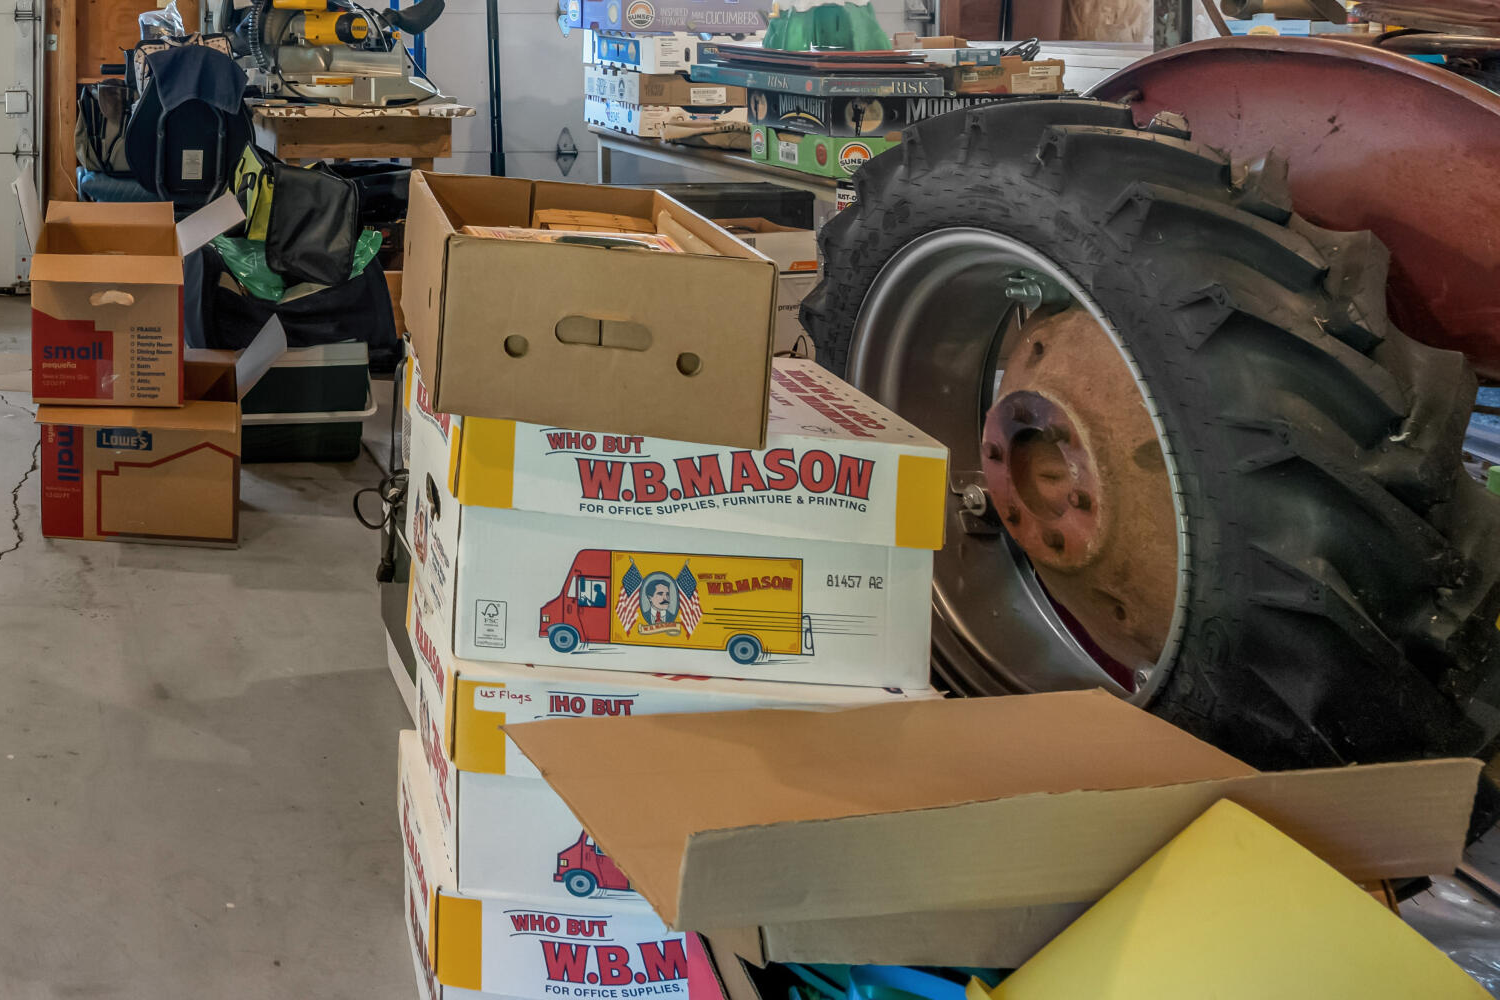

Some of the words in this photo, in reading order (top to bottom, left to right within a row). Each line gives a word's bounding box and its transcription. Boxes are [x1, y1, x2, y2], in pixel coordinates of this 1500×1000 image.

[628, 14, 654, 22] SUNSET
[705, 11, 760, 25] CUCUMBERS
[767, 75, 789, 89] RISK
[891, 81, 930, 95] RISK
[43, 341, 103, 360] small
[42, 361, 77, 370] pequeña
[546, 431, 596, 451] WHO
[602, 435, 645, 455] BUT
[575, 448, 876, 504] W.B.MASON
[579, 503, 604, 514] FOR
[608, 504, 652, 516] OFFICE
[657, 499, 720, 515] SUPPLIES,
[723, 495, 793, 507] FURNITURE
[796, 496, 805, 505] &
[808, 496, 867, 513] PRINTING
[706, 575, 793, 595] W.B.MASON
[826, 574, 862, 589] 81457
[868, 576, 884, 589] A2
[499, 690, 532, 705] Flags
[550, 695, 586, 715] HO
[591, 697, 634, 717] BUT
[510, 913, 560, 933] WHO
[566, 918, 607, 938] BUT
[545, 984, 570, 996] FOR
[574, 987, 618, 998] OFFICE
[621, 983, 685, 999] SUPPLIES,
